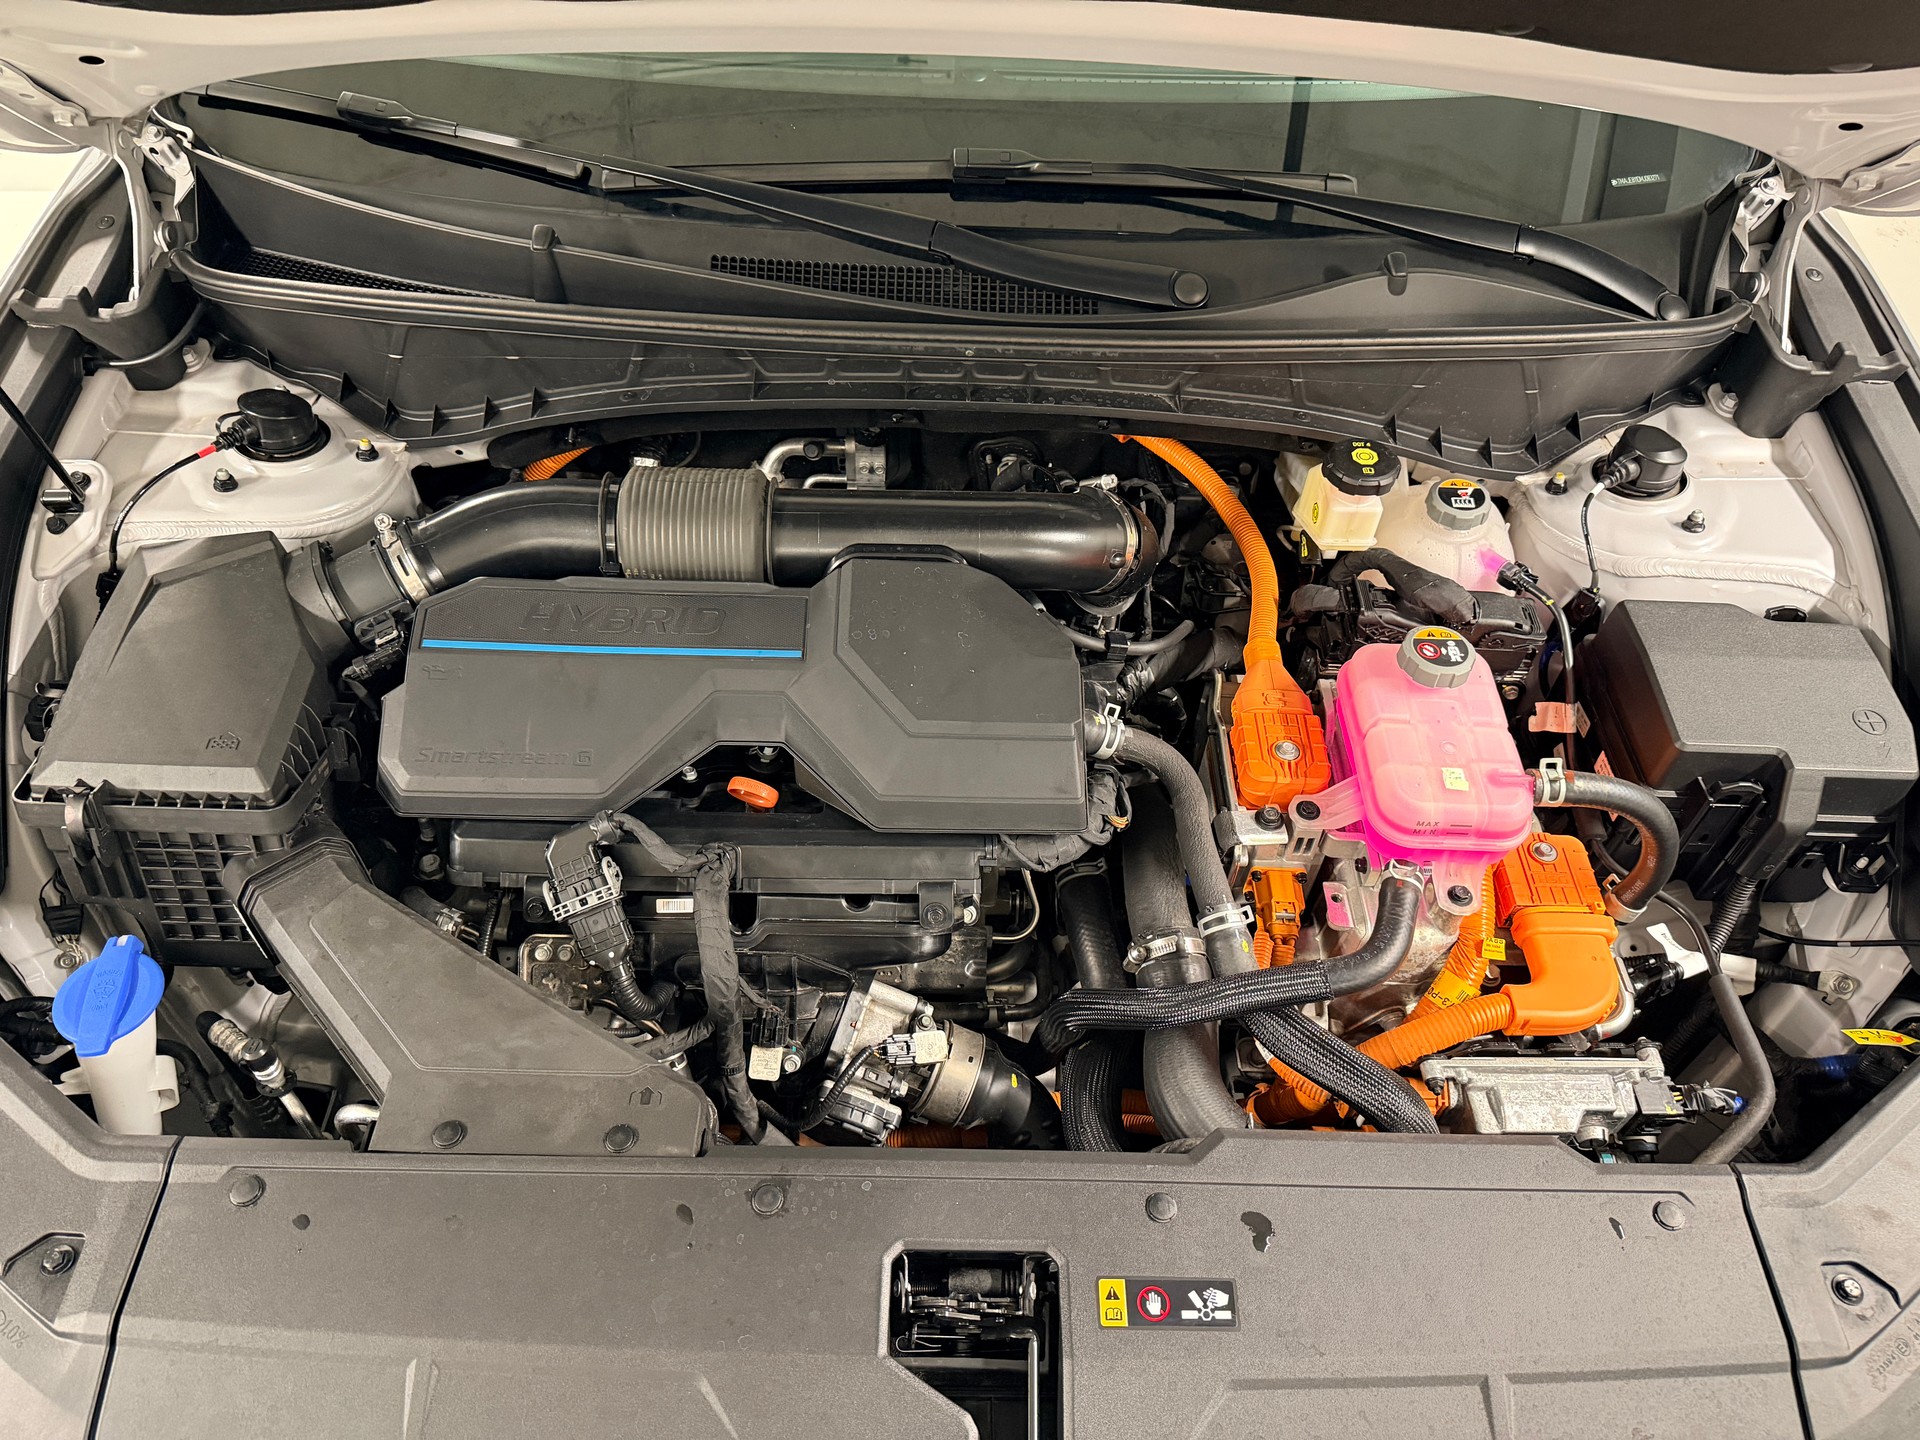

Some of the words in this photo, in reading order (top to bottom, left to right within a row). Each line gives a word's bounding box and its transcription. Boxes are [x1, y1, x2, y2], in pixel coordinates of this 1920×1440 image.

[518, 603, 727, 636] HYBRID
[414, 747, 570, 766] Smartstream
[573, 749, 592, 767] G
[1416, 820, 1441, 828] MAX
[1412, 828, 1437, 836] MIN
